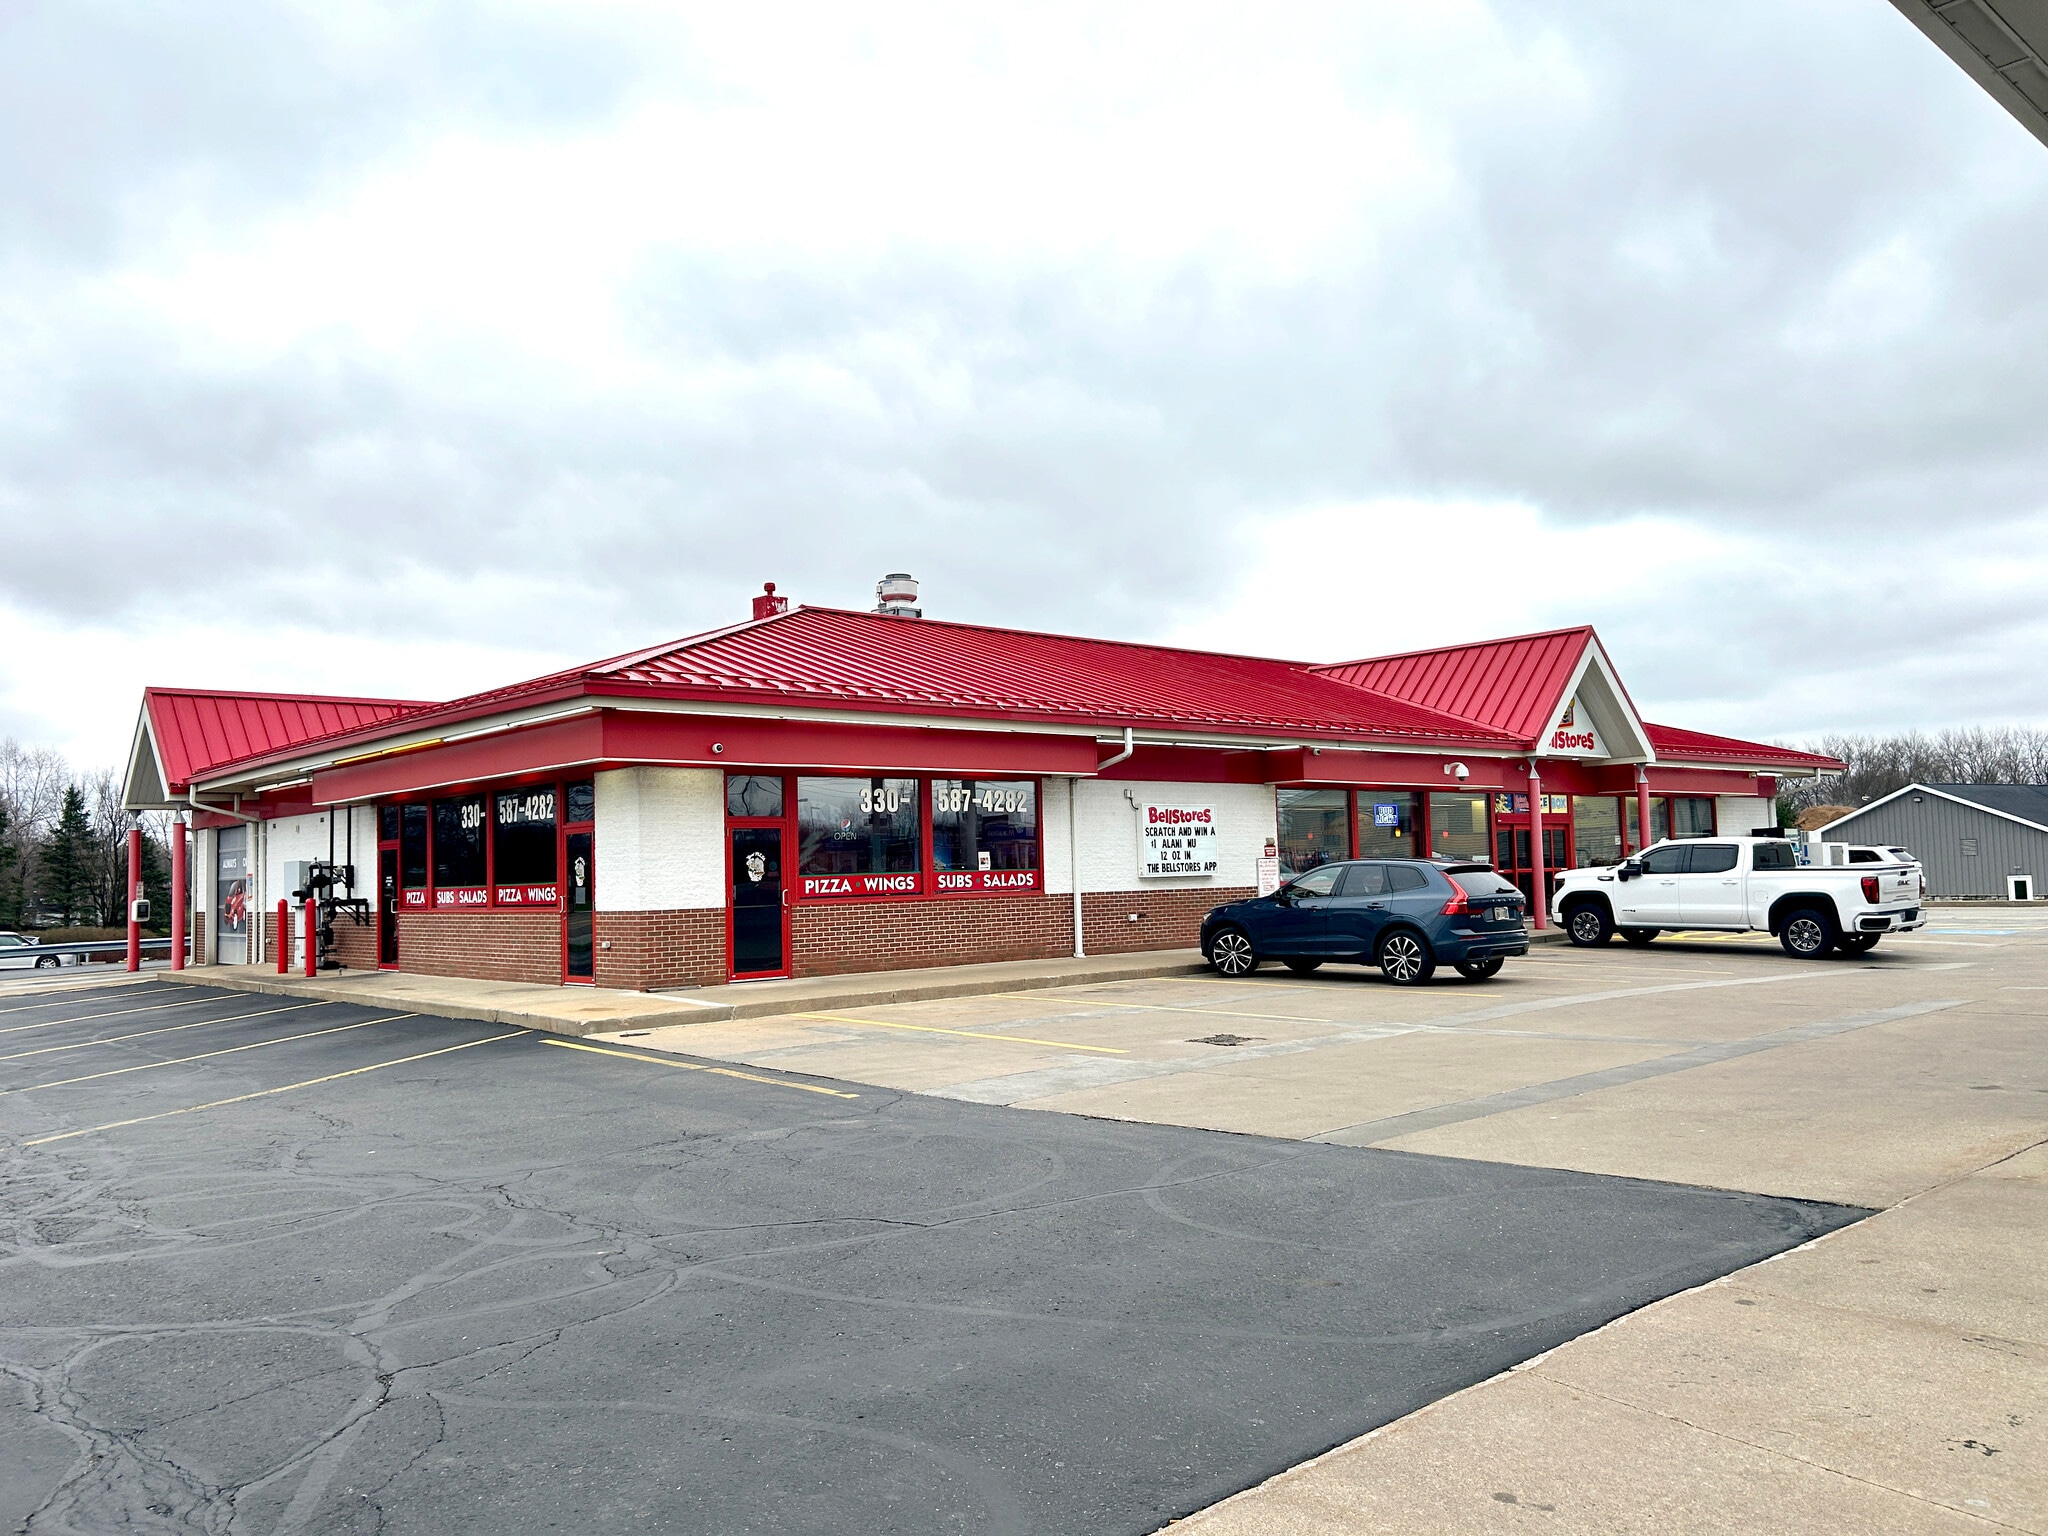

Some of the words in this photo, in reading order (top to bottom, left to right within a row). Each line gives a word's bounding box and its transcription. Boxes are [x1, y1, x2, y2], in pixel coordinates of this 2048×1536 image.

[1549, 731, 1595, 750] llStores
[860, 788, 910, 813] 330-
[937, 788, 1028, 813] 587-4282
[461, 804, 486, 828] 330-
[500, 794, 554, 824] 587-4282
[1148, 806, 1212, 824] BellStores
[1378, 806, 1394, 815] BUD
[1376, 815, 1397, 824] LIGHT
[834, 832, 857, 840] OPEN
[1145, 827, 1176, 836] SCRATCH
[1178, 827, 1192, 836] AND
[1194, 827, 1208, 836] WIN
[1210, 826, 1216, 836] A
[1162, 839, 1182, 848] ALANI
[1187, 838, 1197, 848] NU
[1161, 851, 1168, 860] 12
[1172, 851, 1181, 860] OZ
[1184, 851, 1191, 860] IN
[1147, 863, 1160, 873] THE
[1162, 862, 1201, 872] BELLSTORES
[1204, 862, 1217, 871] APP
[805, 878, 852, 894] PIZZA
[864, 876, 915, 891] WINGS
[938, 874, 973, 888] SUBS
[983, 873, 1034, 887] SALADS
[406, 891, 425, 903] PIZZA
[436, 891, 454, 903] SUBS
[459, 890, 487, 903] SALADS
[498, 888, 522, 902] PIZZA
[528, 887, 556, 901] WINGS
